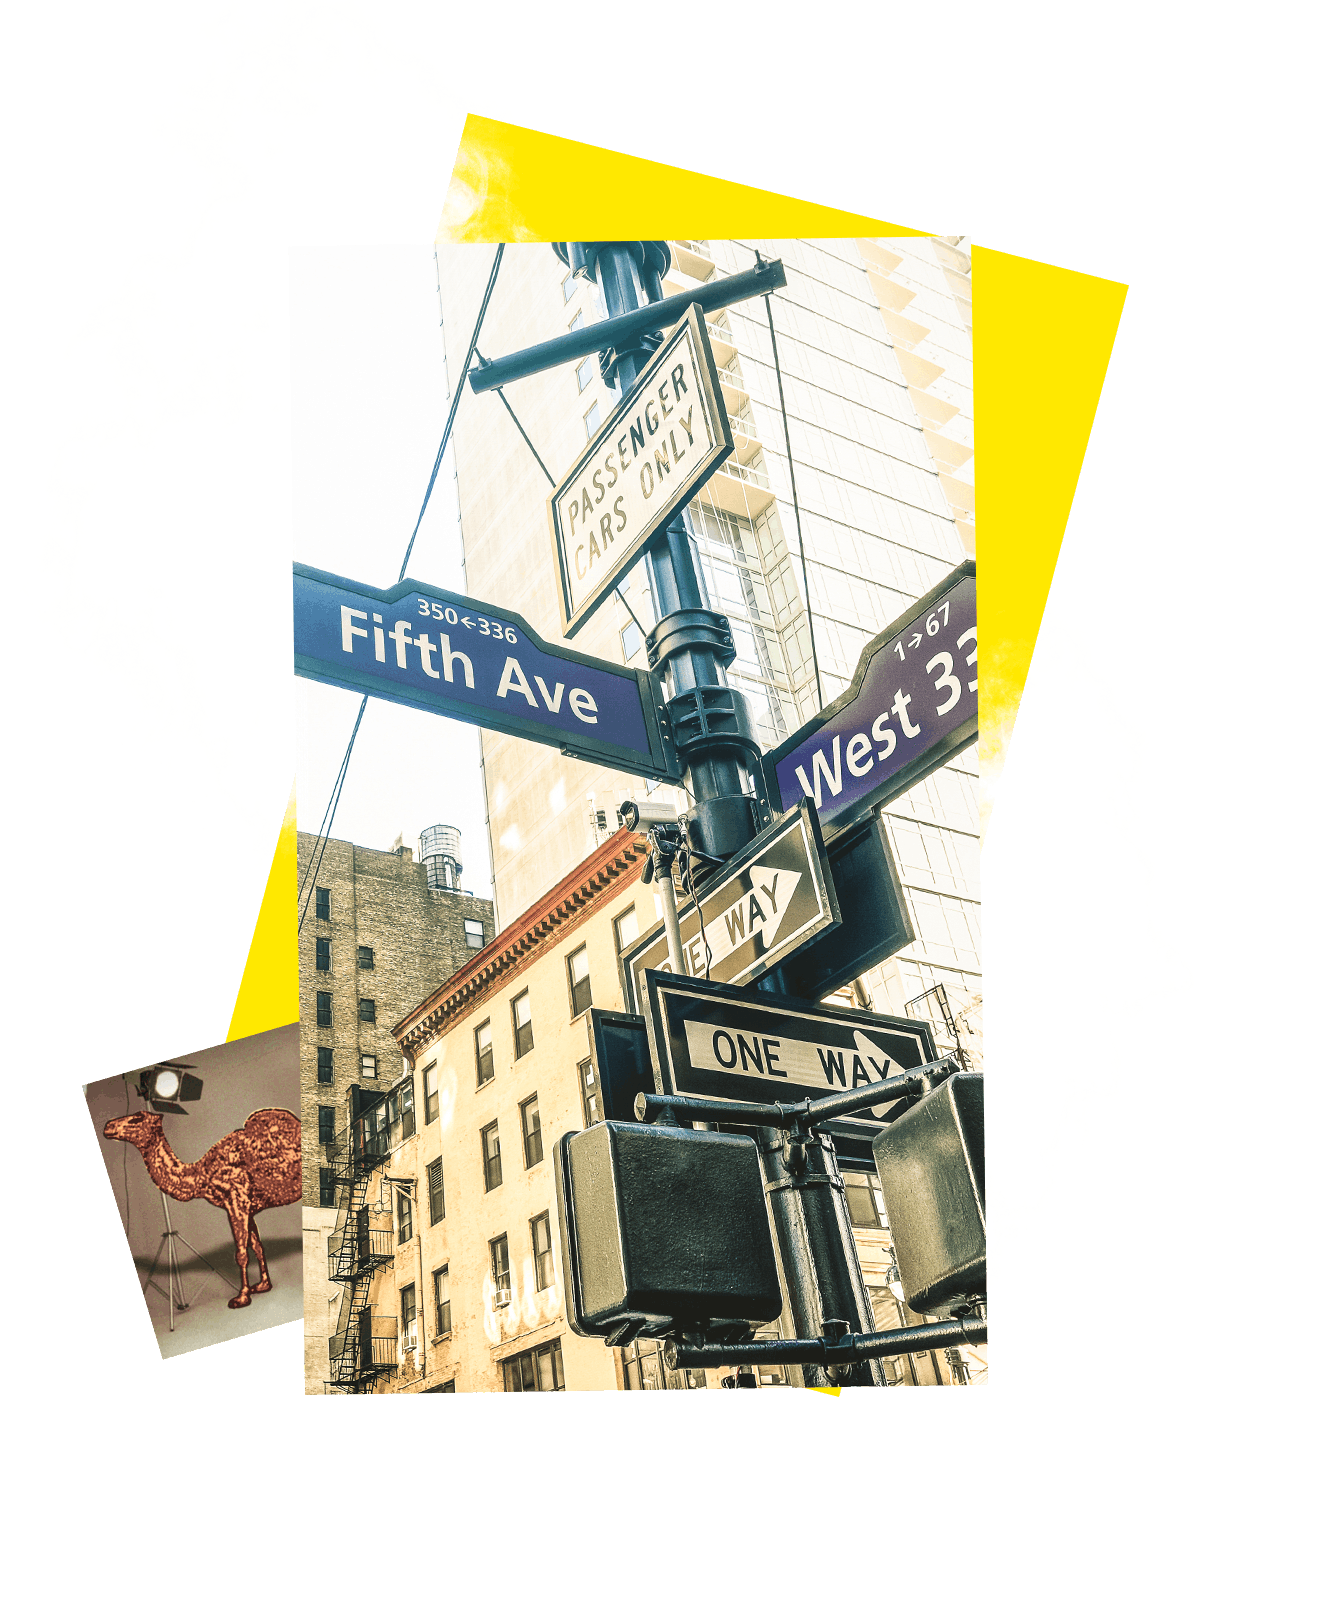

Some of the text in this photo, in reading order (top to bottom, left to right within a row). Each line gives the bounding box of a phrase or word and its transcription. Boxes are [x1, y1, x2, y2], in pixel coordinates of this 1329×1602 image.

[568, 364, 688, 536] PASSENGER
[574, 405, 694, 580] CARS ONLY
[340, 604, 599, 724] Fifth Ave
[417, 598, 518, 643] 350 336
[893, 601, 949, 661] 1 67
[794, 688, 921, 809] West
[724, 872, 780, 946] WAY
[712, 1029, 891, 1089] ONE WAY
